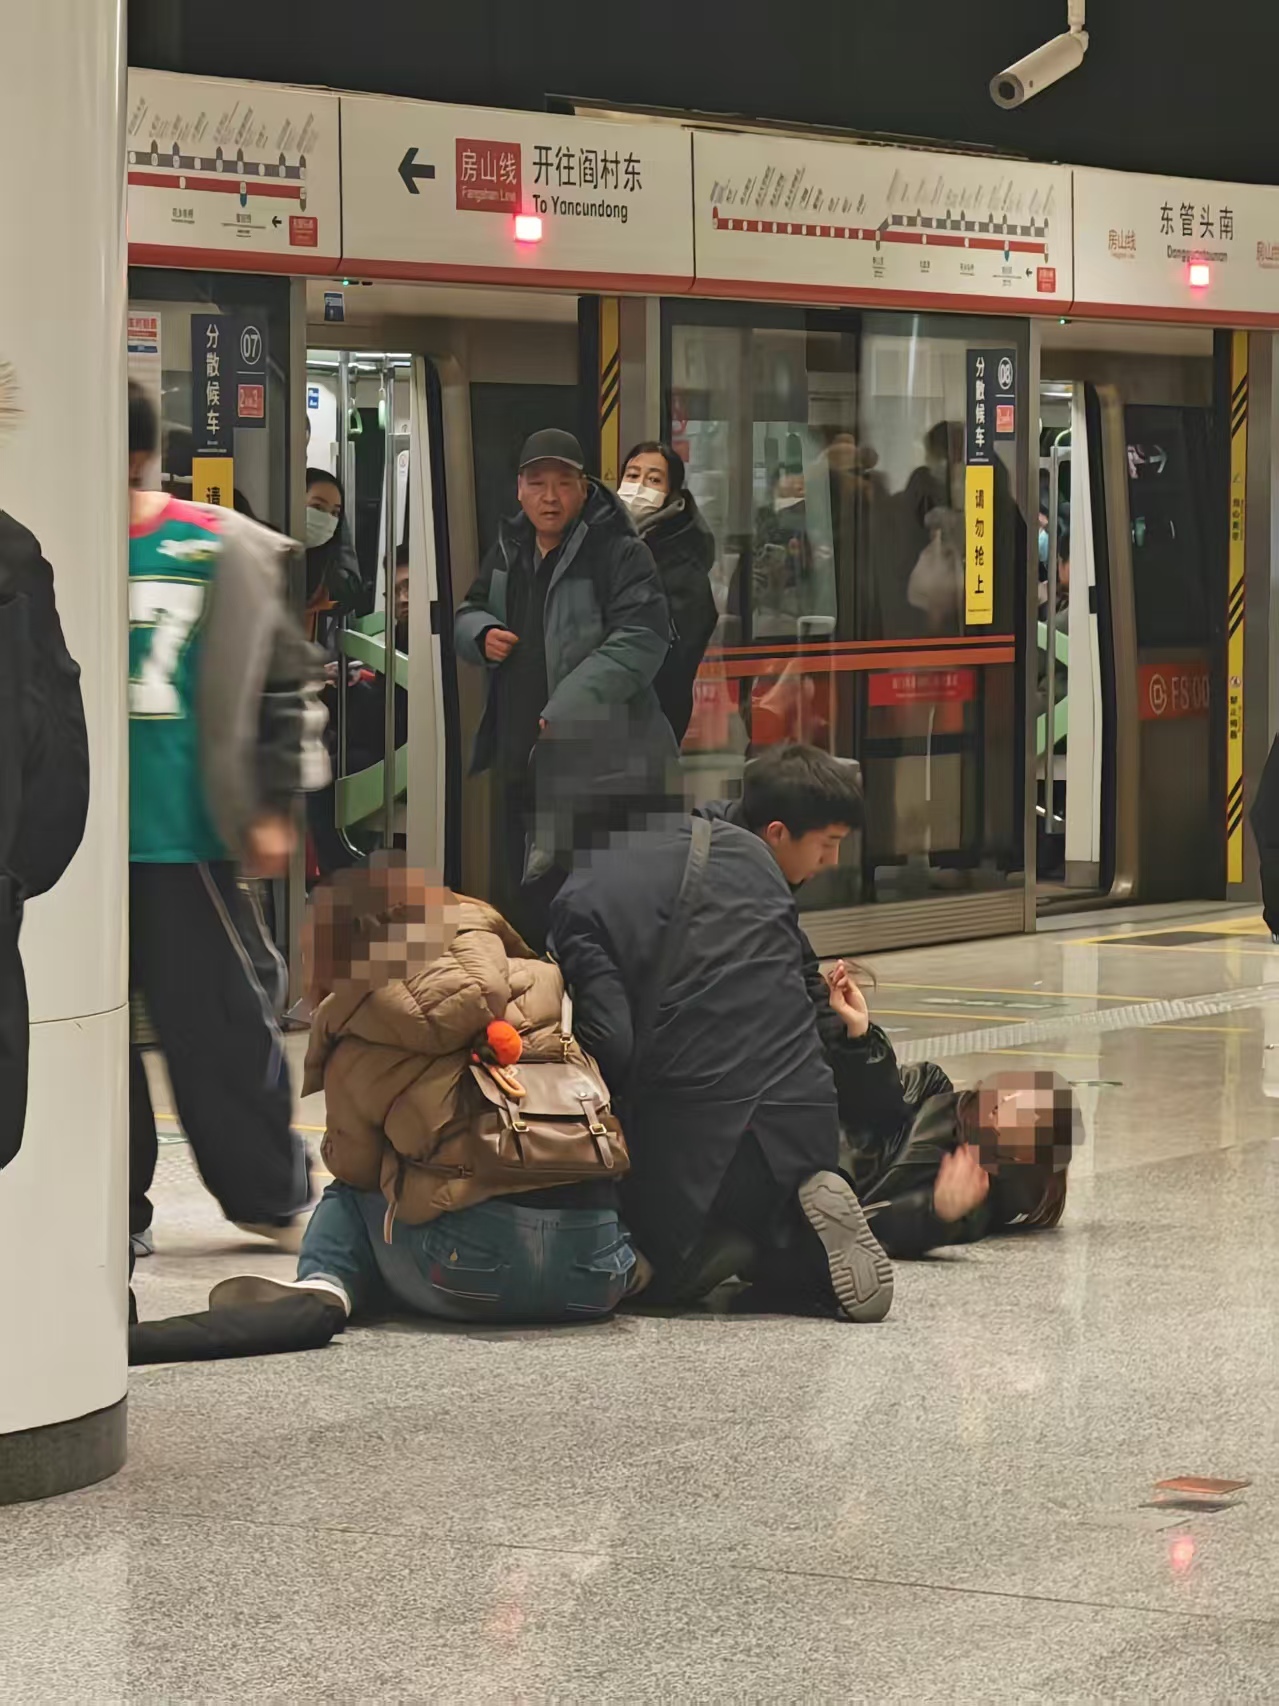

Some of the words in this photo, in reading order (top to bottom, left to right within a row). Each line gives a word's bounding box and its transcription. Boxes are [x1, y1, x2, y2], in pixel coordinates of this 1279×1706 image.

[460, 149, 517, 185] 房山线
[533, 145, 642, 192] 开往阎村东
[532, 194, 548, 214] To
[550, 195, 629, 223] Yancundong
[1160, 200, 1234, 241] 东管头南
[243, 334, 259, 358] 07
[206, 323, 220, 435] 分散候车
[1001, 364, 1010, 383] 08
[975, 356, 986, 448] 分散候车
[974, 489, 985, 594] 请勿抢上
